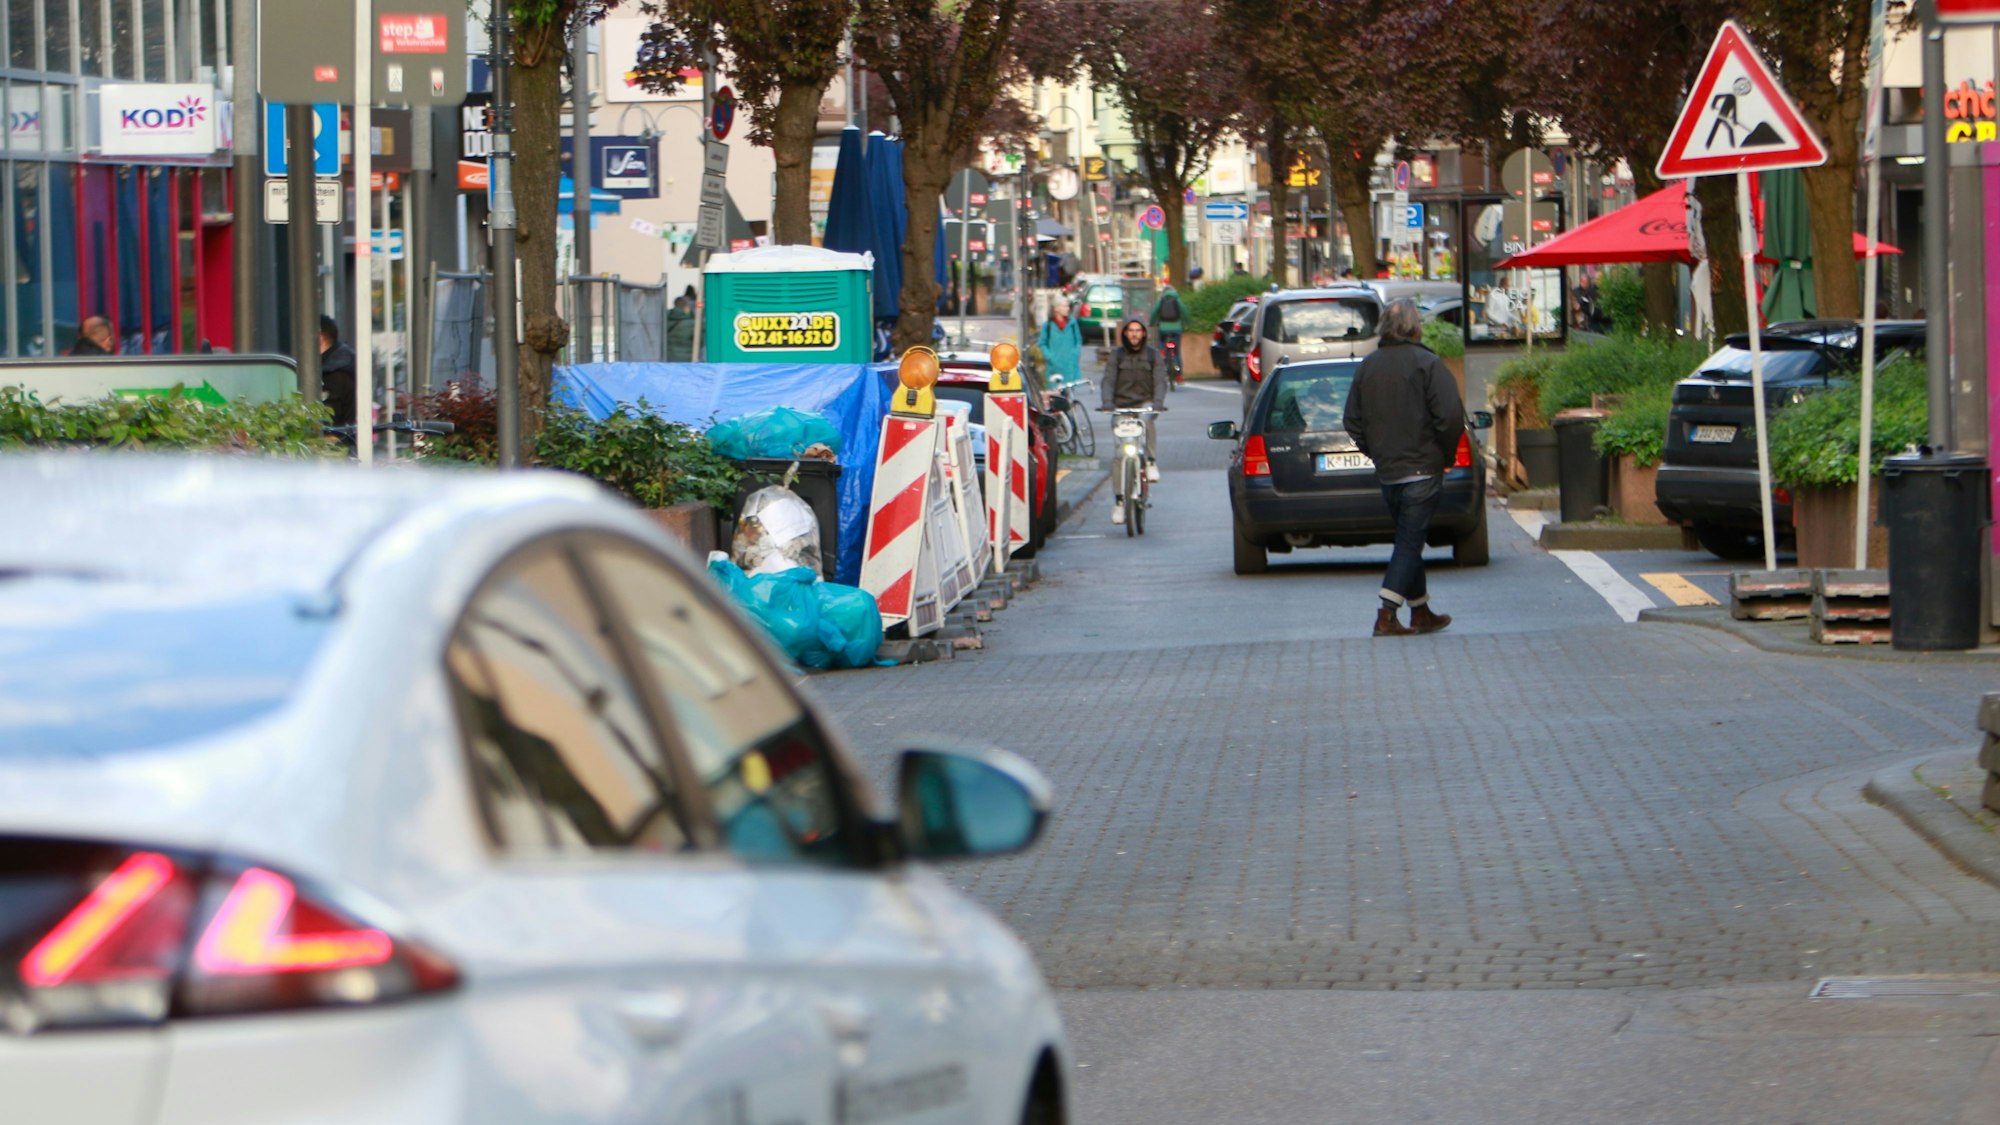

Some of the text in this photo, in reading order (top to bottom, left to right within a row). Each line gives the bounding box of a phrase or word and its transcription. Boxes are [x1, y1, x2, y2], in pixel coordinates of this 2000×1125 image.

[738, 330, 835, 346] 02241-16520
[1327, 456, 1336, 468] K
[1343, 455, 1361, 467] HD
